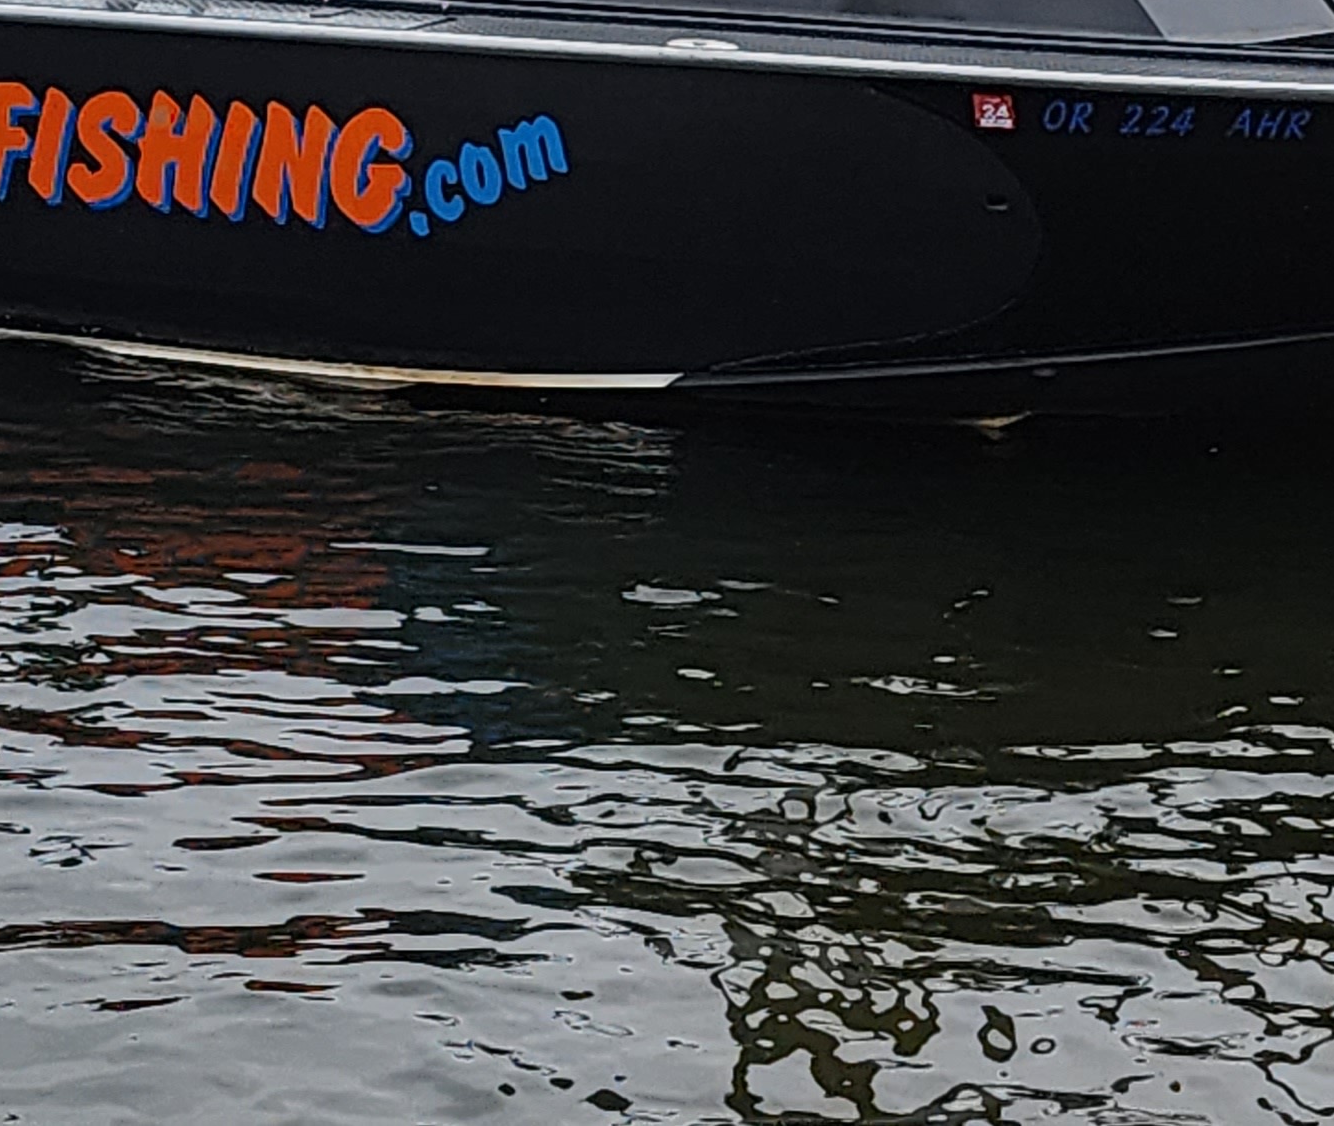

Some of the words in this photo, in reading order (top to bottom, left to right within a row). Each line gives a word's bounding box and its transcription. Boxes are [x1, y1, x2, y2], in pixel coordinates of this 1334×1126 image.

[982, 104, 1010, 122] 24
[1043, 99, 1094, 134] OR
[1119, 103, 1196, 138] 224
[1225, 107, 1312, 141] AHR
